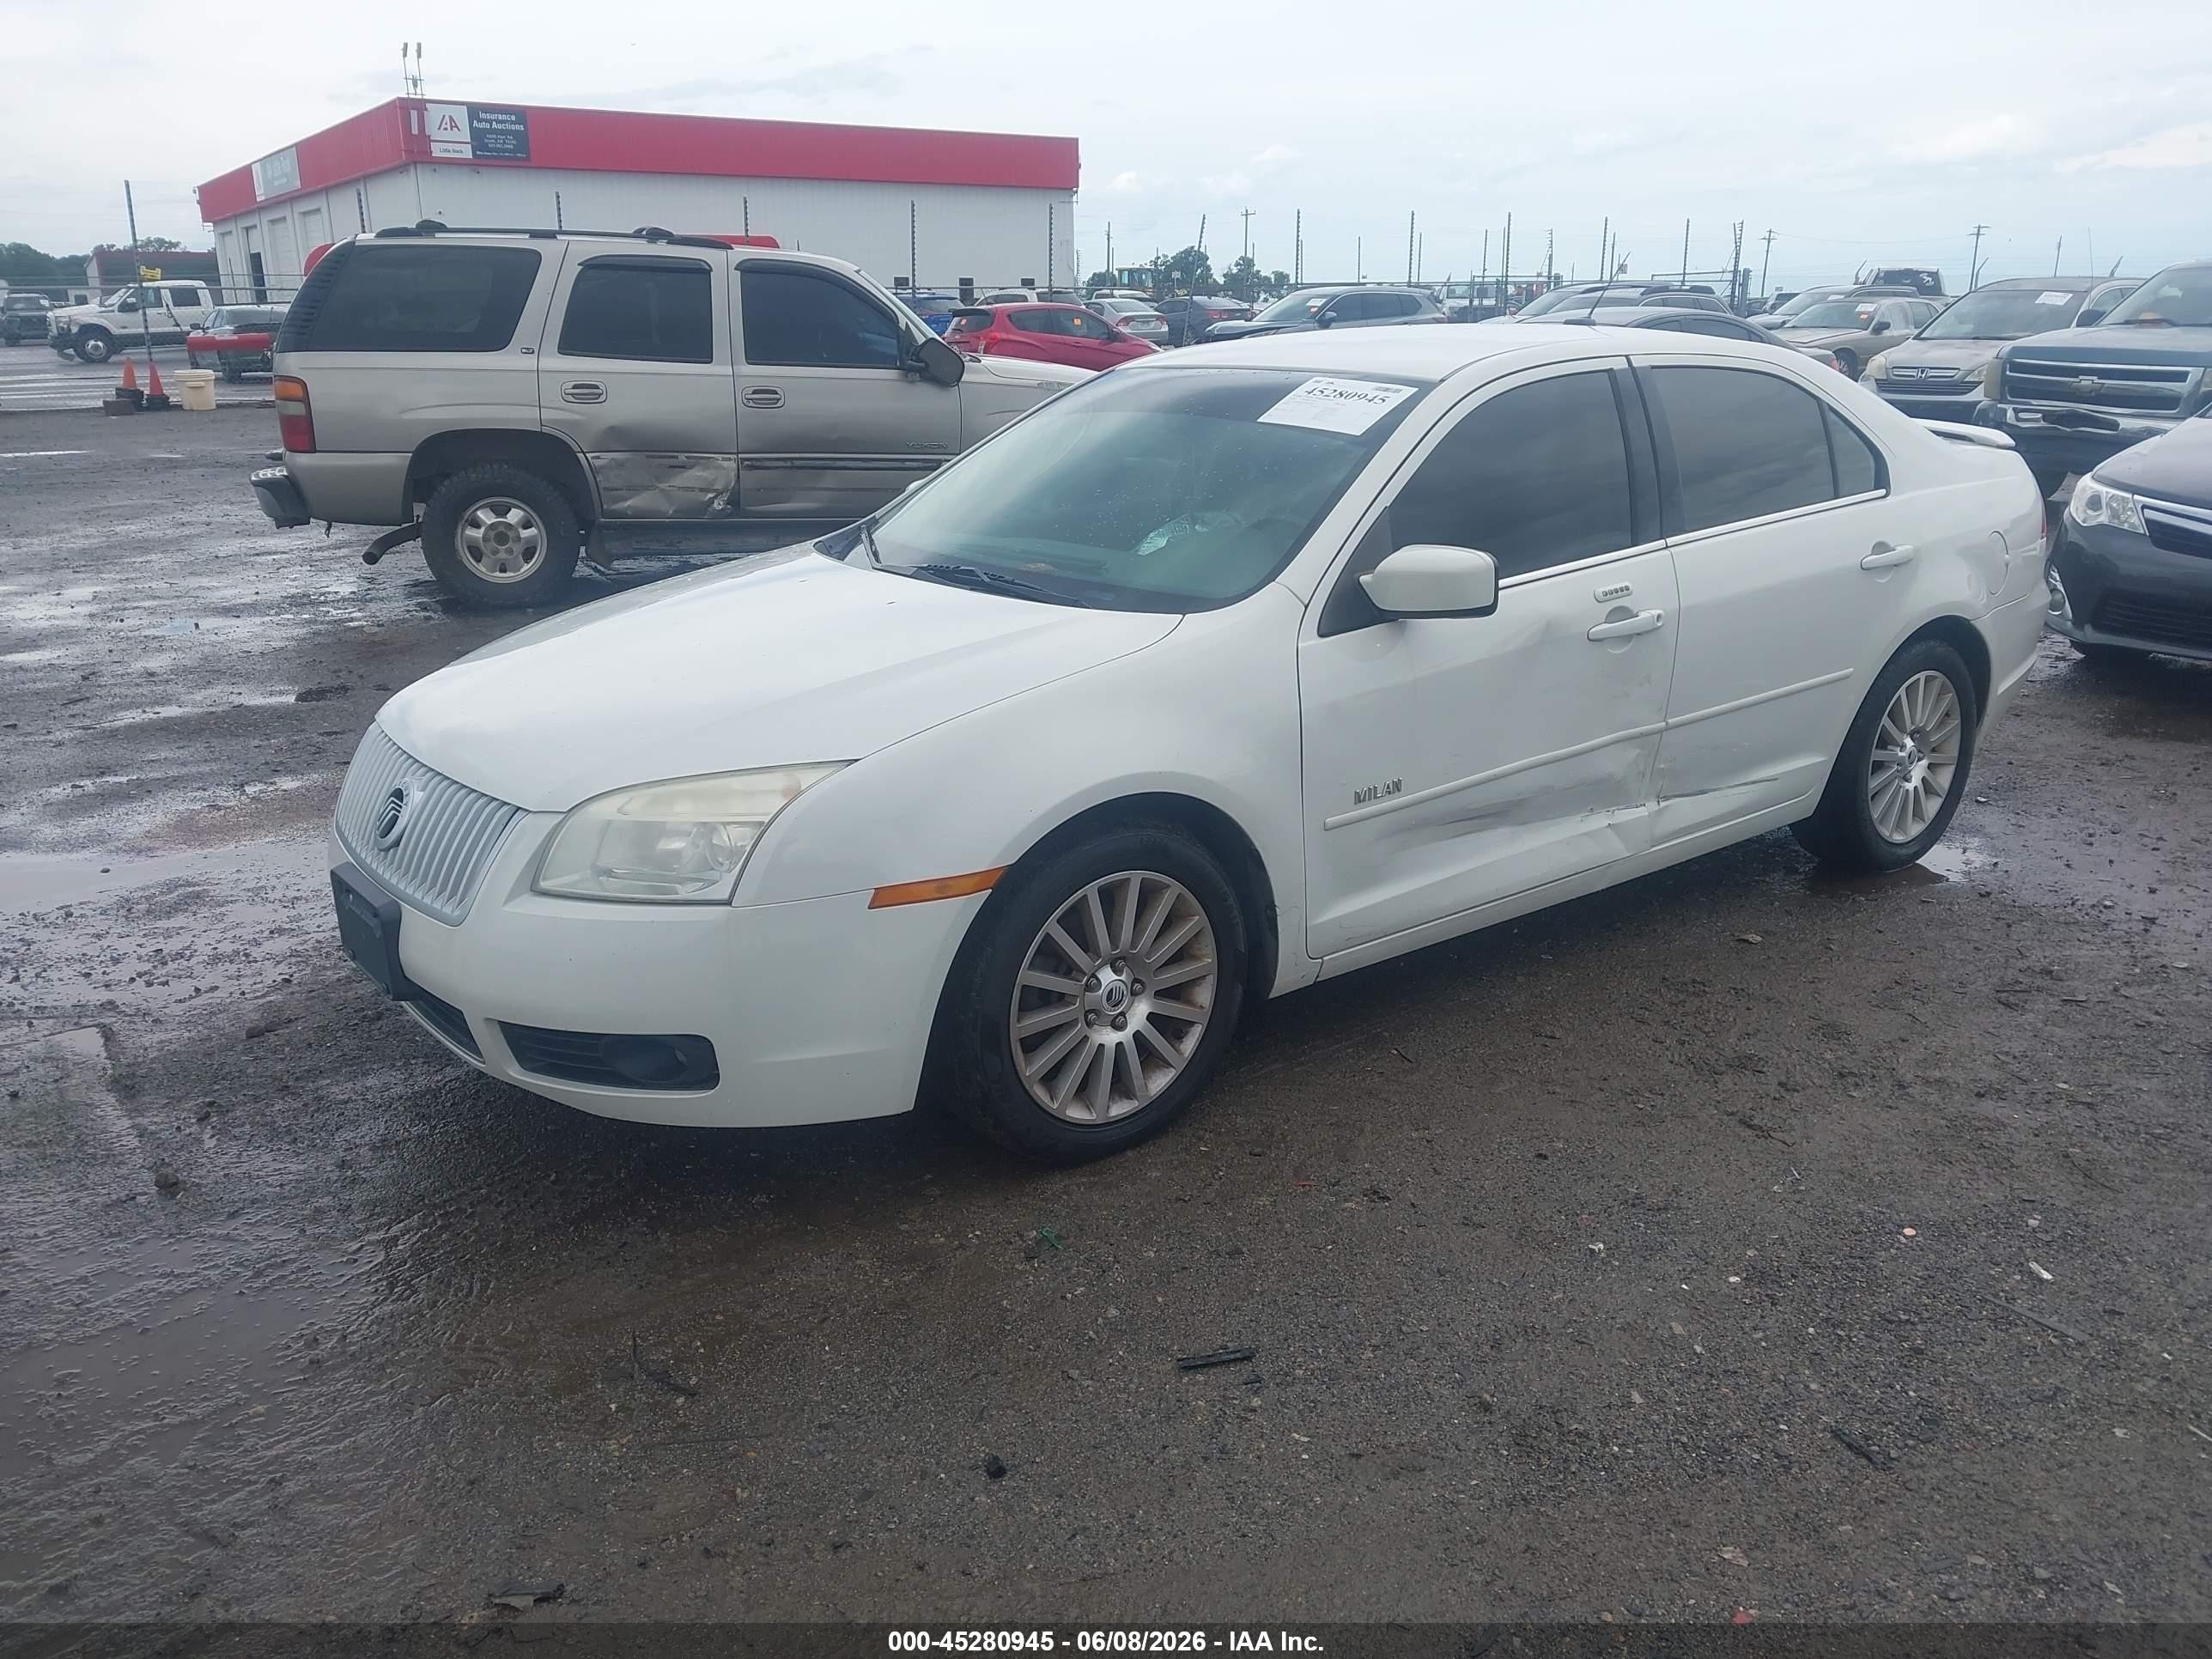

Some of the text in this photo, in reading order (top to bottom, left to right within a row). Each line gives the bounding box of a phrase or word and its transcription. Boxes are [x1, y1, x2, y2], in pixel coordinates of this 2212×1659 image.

[479, 110, 516, 121] Insurance
[472, 120, 525, 131] Auto Auctions
[1304, 386, 1392, 404] 45280945
[1353, 777, 1402, 805] MILAN
